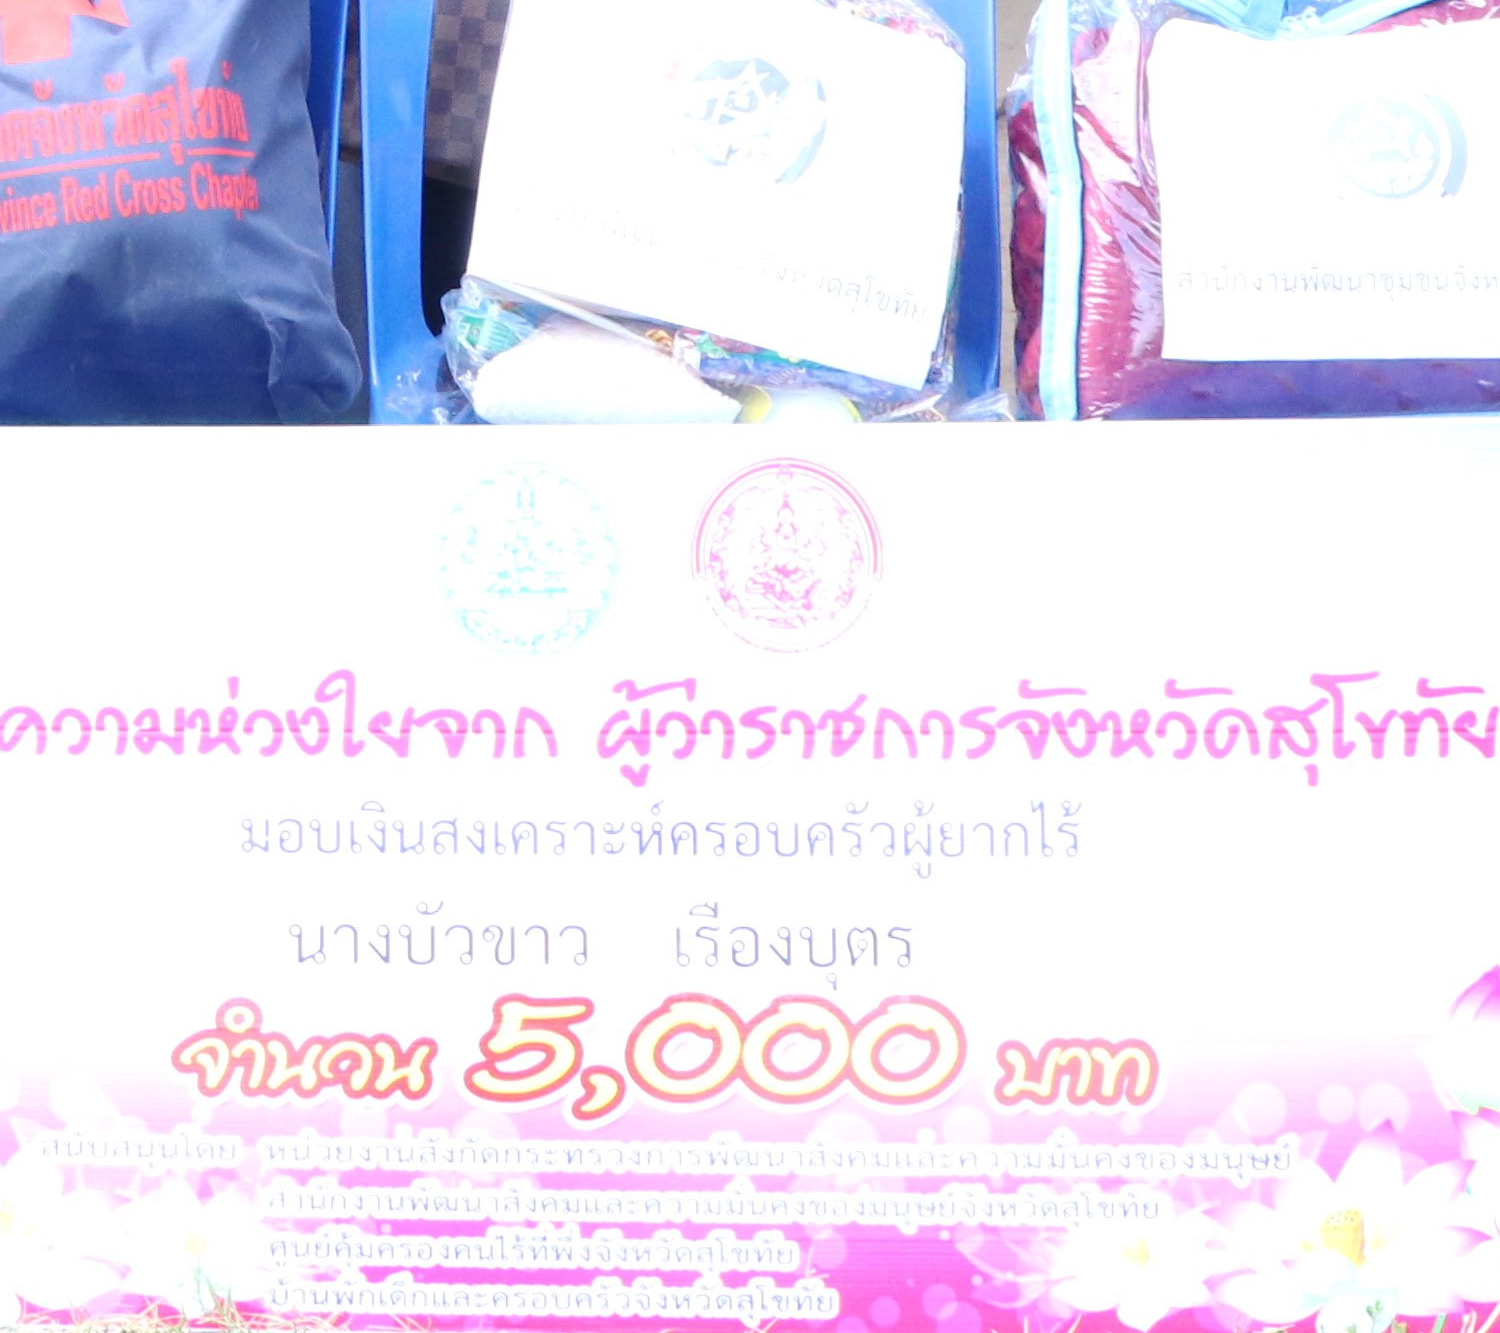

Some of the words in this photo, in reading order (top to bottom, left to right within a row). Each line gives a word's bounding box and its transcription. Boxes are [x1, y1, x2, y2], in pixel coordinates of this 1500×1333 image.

[60, 173, 109, 225] Red
[113, 169, 187, 219] Cross
[596, 671, 1500, 788] ผู้ว่าราชการจังหวัดสุโขทัย
[241, 799, 1083, 879] มอบเงินสงเคราะห์ครอบครัวผู้ยากไร้
[288, 900, 588, 967] นางบัวขาว
[674, 901, 914, 992] เรืองบุตร
[171, 996, 438, 1101] จำนวน
[465, 993, 966, 1123] 5,000
[997, 1038, 1160, 1106] บาท
[40, 1131, 238, 1168] สนับสนุนโดย
[265, 1134, 1292, 1180] หน่วยงานสังกัดกระทรวงการพัฒนาสังคมและความมั่นคงของมนุษย์
[269, 1182, 1159, 1226] สำนักงานพัฒนาสังคมและความมั่นคงของมนุษย์จังหวัดสุโขทัย
[269, 1228, 794, 1274] ศูนย์คุ้มครองคนไร้ที่พึ่งจังหวัดสุโขทัย
[268, 1278, 833, 1322] บ้านพักเด็กและครอบครัวจังหวัดสุโขทัย
